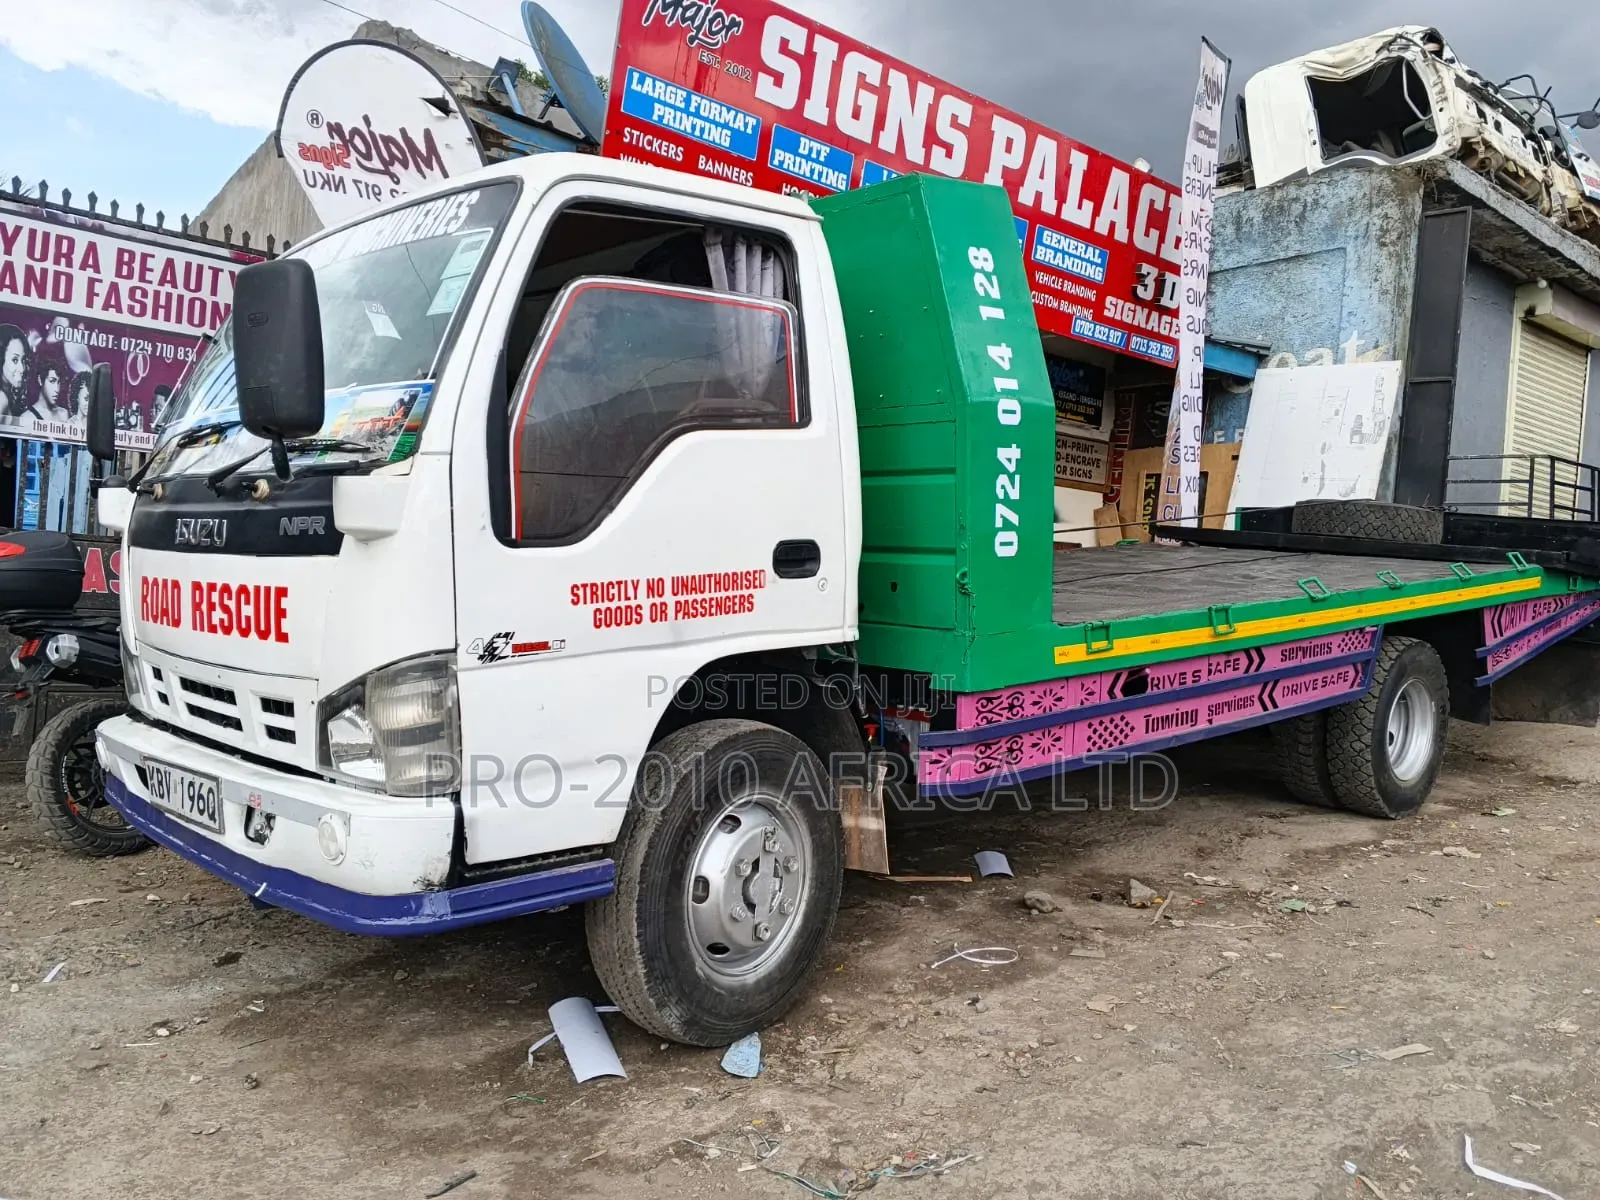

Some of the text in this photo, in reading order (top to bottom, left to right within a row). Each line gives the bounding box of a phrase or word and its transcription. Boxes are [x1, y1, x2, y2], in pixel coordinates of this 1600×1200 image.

[642, 0, 744, 48] Major
[699, 50, 752, 82] EST. 2012
[631, 71, 757, 136] LARGE FORMAT
[652, 103, 731, 148] PRINTING
[754, 14, 1182, 268] SIGNS PALACE
[623, 127, 685, 163] STICKERS
[698, 154, 754, 187] BANNERS
[798, 137, 831, 162] DTF
[772, 149, 848, 192] PRINTING
[0, 221, 102, 275] YURA
[1035, 246, 1104, 280] BRANDING
[1042, 229, 1103, 264] GENERAL
[0, 259, 232, 331] AND FASHION
[1035, 270, 1097, 302] VEHICLE BRANDING
[1031, 290, 1094, 321] CUSTOM BRANDING
[1103, 295, 1182, 339] SIGNAGE
[55, 324, 118, 350] CONTACT:
[120, 337, 153, 355] 0724
[155, 342, 175, 359] 710
[1074, 319, 1094, 337] 0702
[1094, 324, 1109, 341] 832
[1109, 328, 1122, 345] 917
[1131, 335, 1175, 360] 0713 252 352
[966, 246, 1022, 558] 0724 014 128
[1069, 466, 1093, 480] SIGNS
[174, 516, 326, 547] ISUZU NPR
[570, 569, 766, 607] STRICTLY NO UNAUTHORISED
[141, 575, 289, 643] ROAD RESCUE
[593, 593, 755, 630] GOODS OR PASSENGERS
[1279, 640, 1333, 663] services
[1143, 670, 1350, 736] Towing services DRIVE SAFE
[147, 764, 217, 823] KBV 196Q
